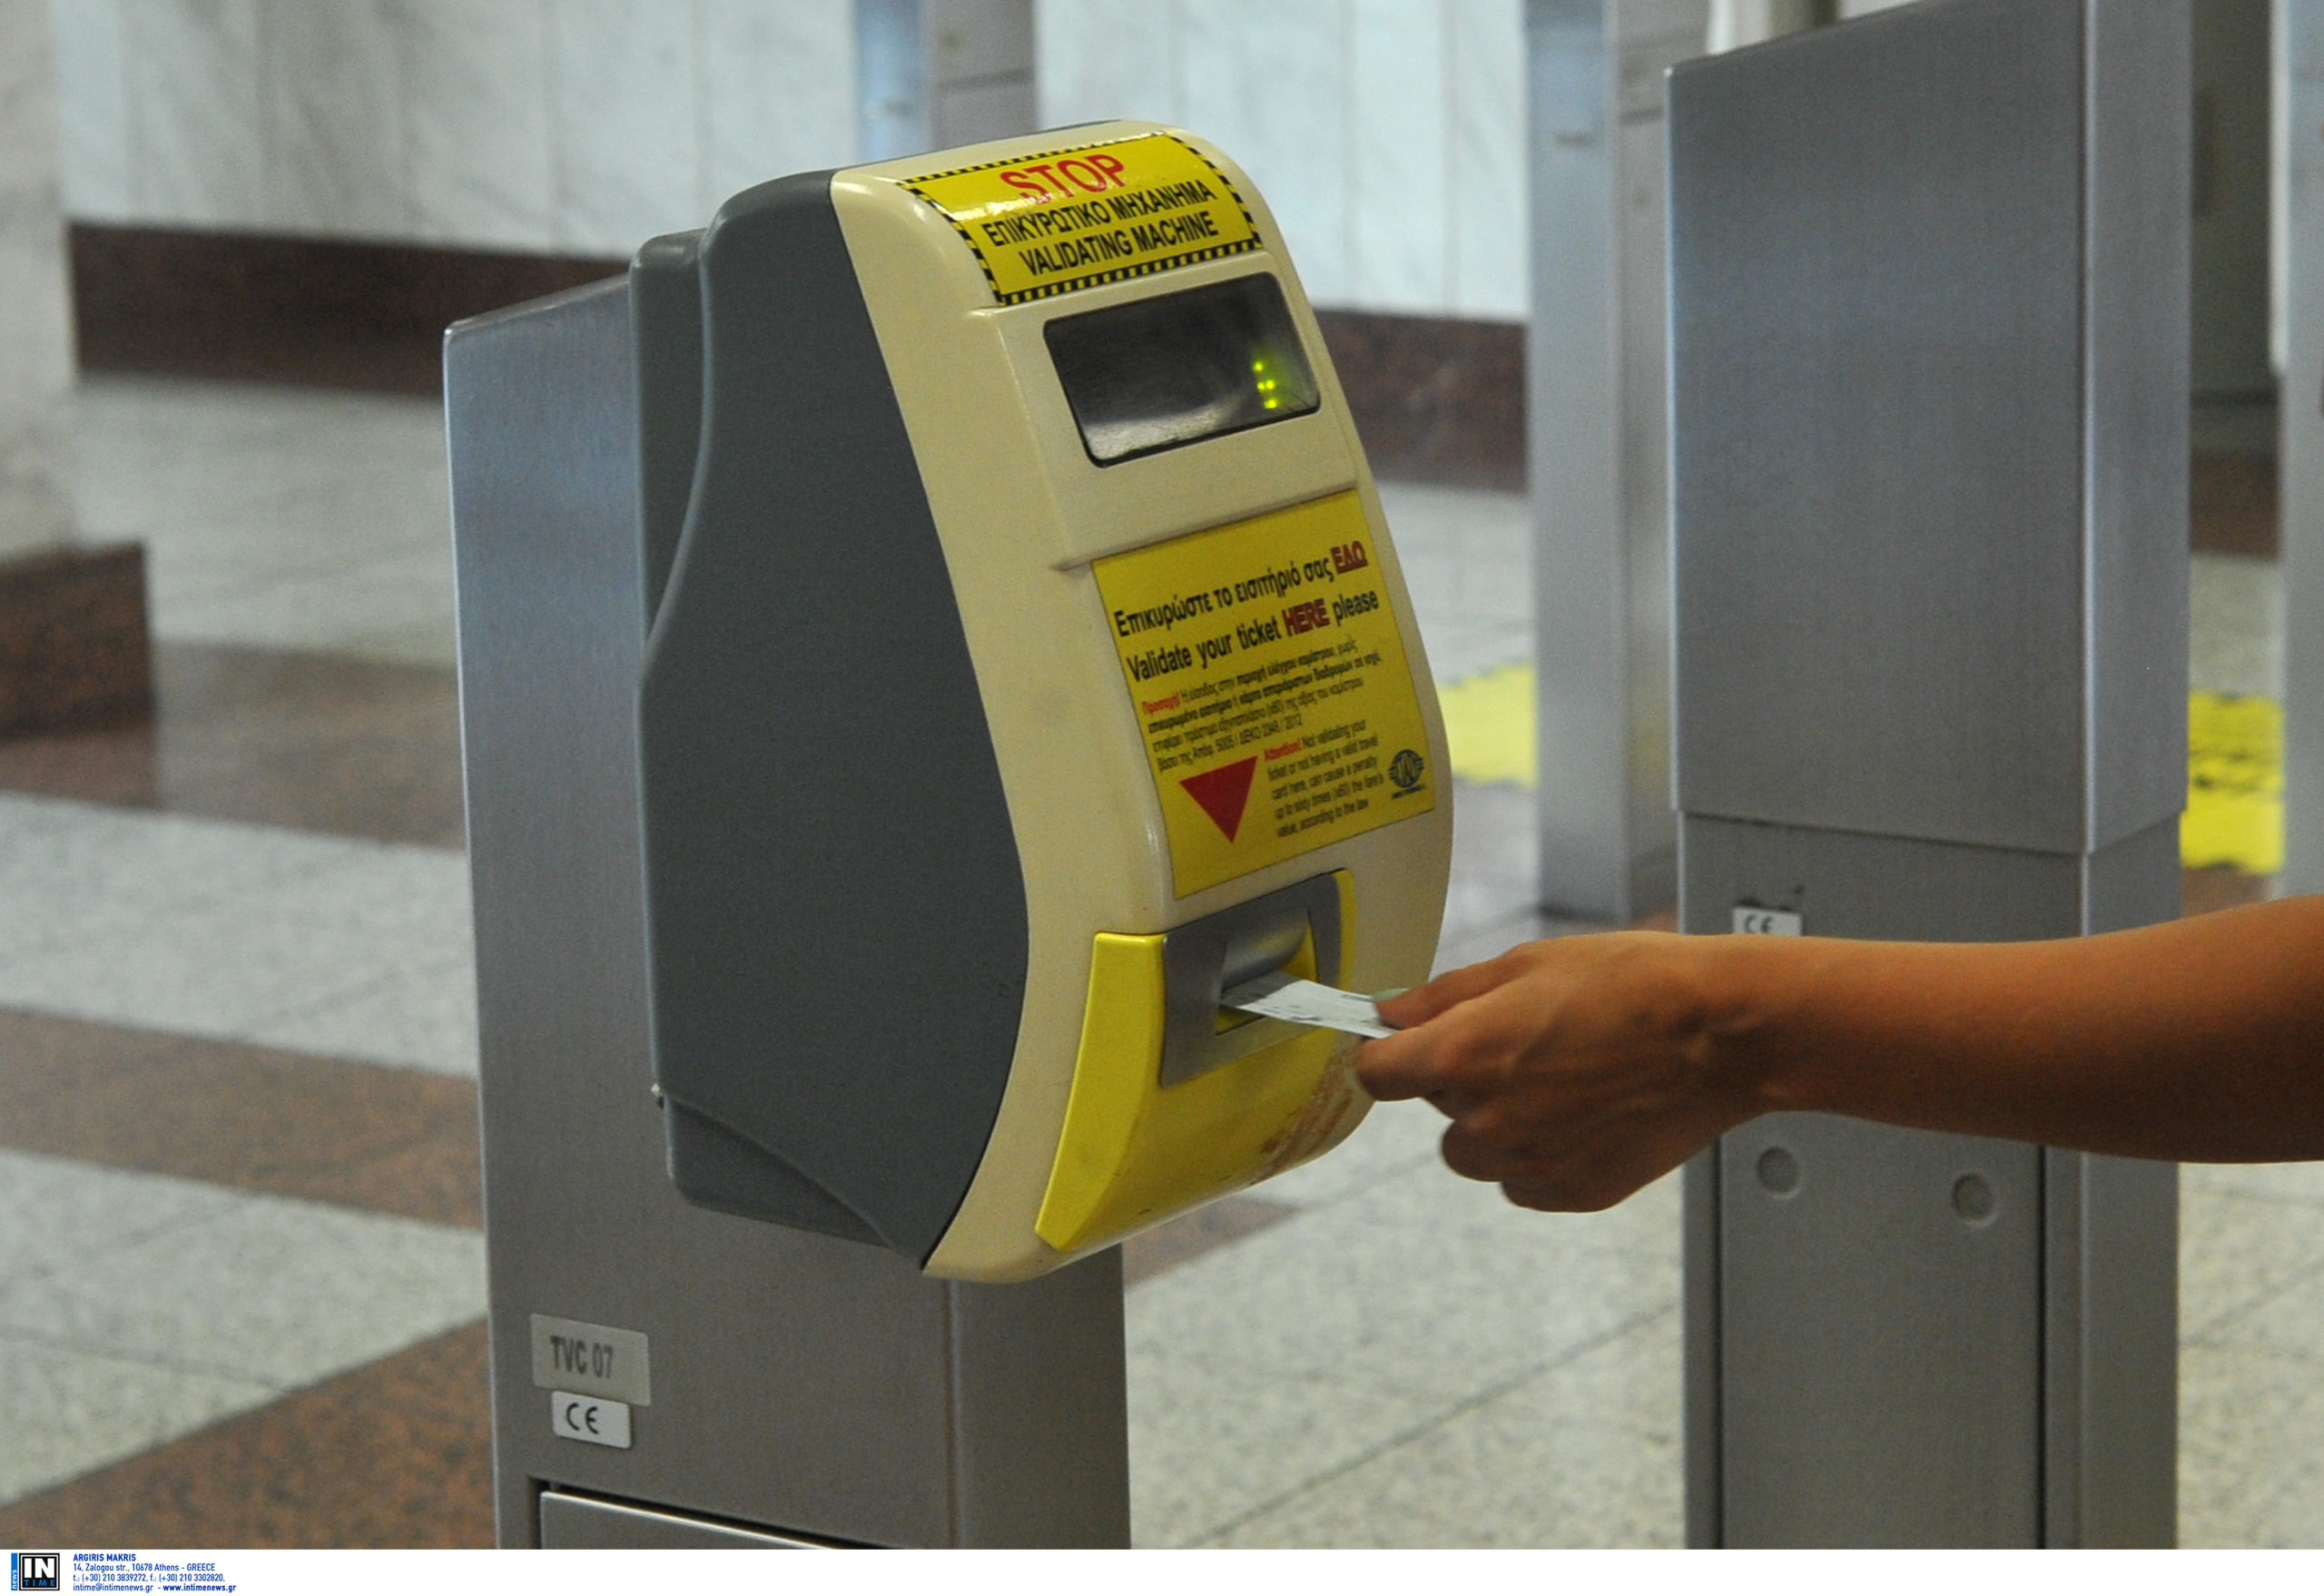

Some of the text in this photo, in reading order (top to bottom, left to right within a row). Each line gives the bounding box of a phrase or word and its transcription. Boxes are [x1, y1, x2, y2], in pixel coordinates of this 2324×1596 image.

[1000, 153, 1125, 204] STOP
[981, 179, 1217, 248] ΕΠΙΚΥΡΩΤΙΚΟ ΜΗΧΑΝΗΜΑ
[1019, 212, 1218, 276] VALIDATING MACHINE
[1114, 540, 1369, 637] Επικυρώστε το εισιτήριό σας ΕΔΩ
[1127, 589, 1379, 682] Validate your ticket HERE please
[550, 1335, 614, 1379] TVC 07
[566, 1402, 599, 1435] CE
